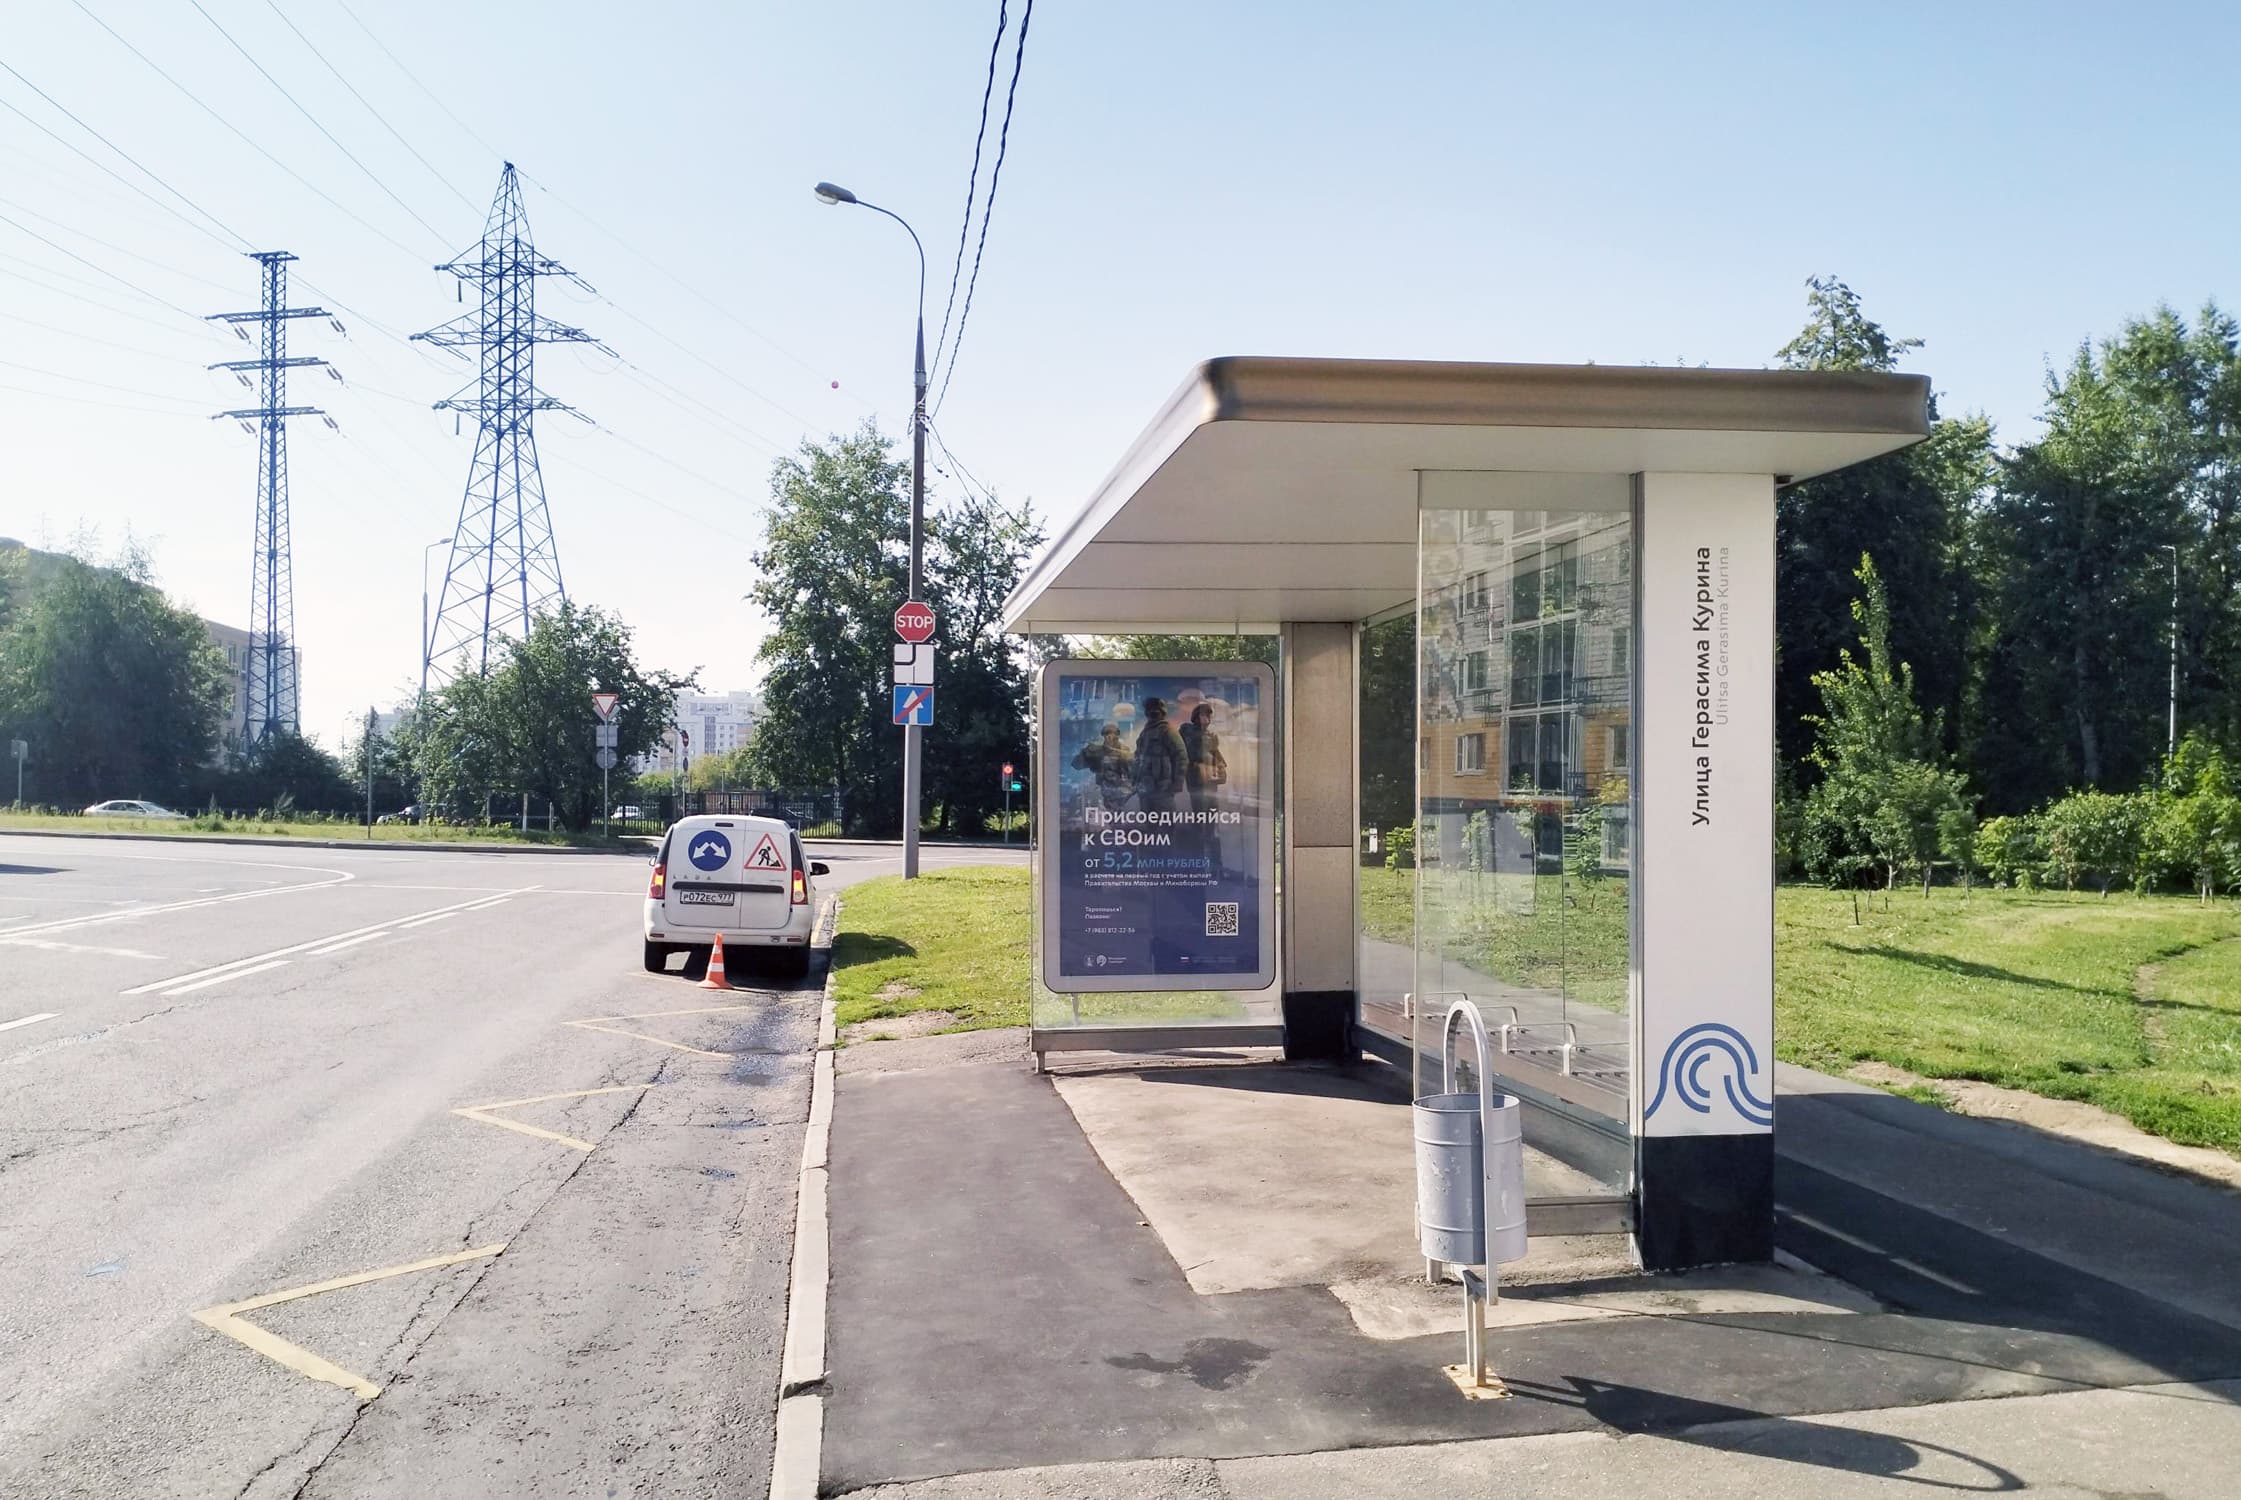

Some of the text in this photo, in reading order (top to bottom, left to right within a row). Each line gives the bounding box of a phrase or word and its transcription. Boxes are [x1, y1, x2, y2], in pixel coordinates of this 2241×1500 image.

[897, 615, 933, 629] STOP
[1715, 547, 1728, 725] Ulitsa Gerasima Kurina
[1692, 547, 1714, 826] Улица Герасима Курина
[1084, 807, 1241, 827] Присоединяйся
[1085, 829, 1171, 846] к СВОим
[1085, 858, 1100, 868] от
[1103, 851, 1133, 871] 5,2
[1167, 856, 1211, 869] РУБЛЕЙ
